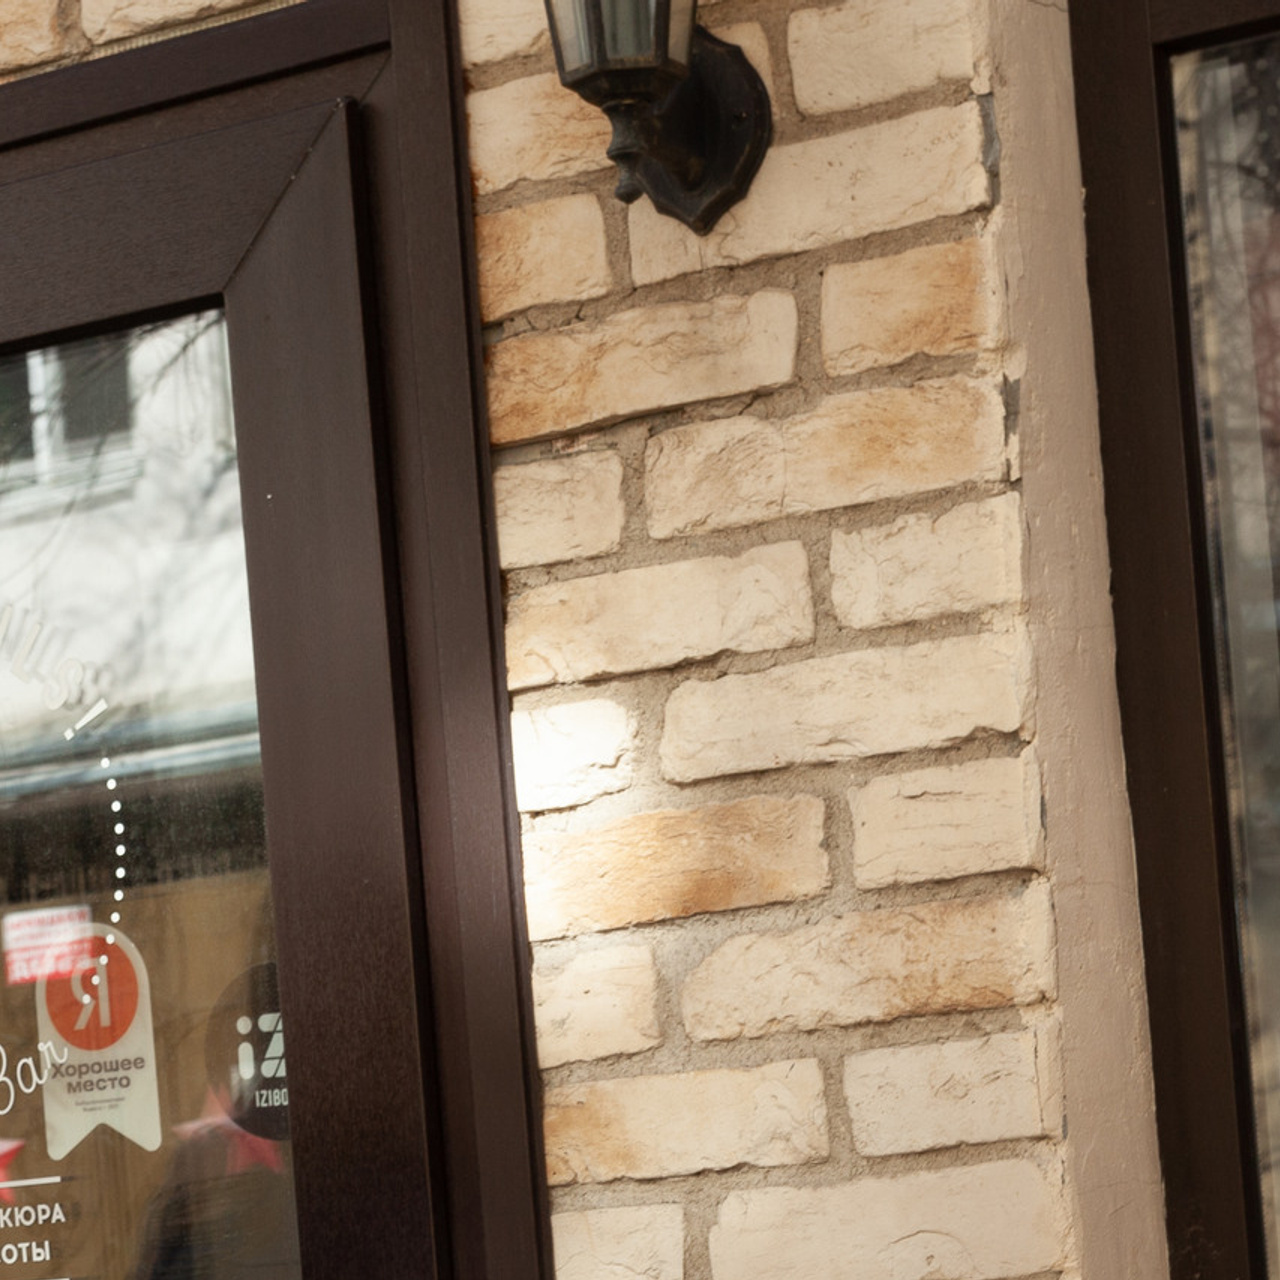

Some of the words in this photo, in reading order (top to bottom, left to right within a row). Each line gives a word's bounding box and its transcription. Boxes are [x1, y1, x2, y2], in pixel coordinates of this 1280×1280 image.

[70, 956, 112, 1032] Я
[51, 1056, 145, 1080] Хорошее
[66, 1075, 131, 1094] место
